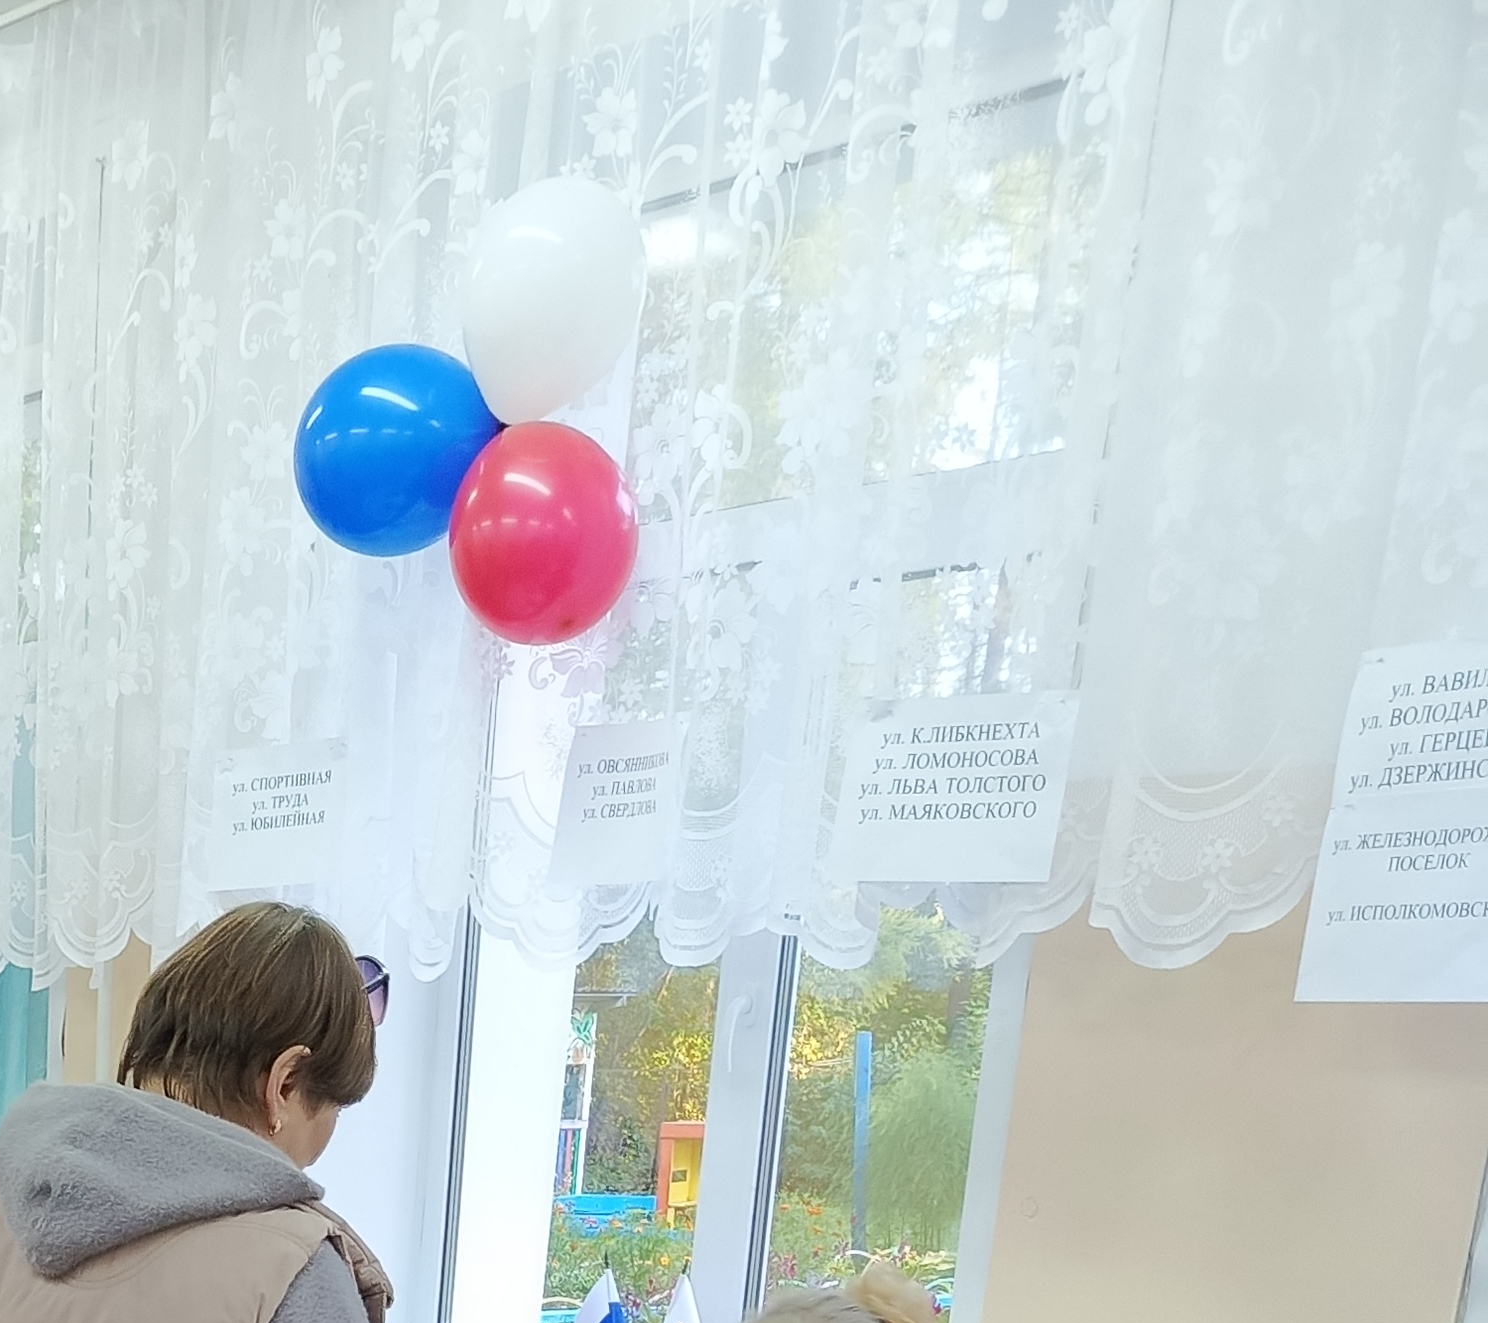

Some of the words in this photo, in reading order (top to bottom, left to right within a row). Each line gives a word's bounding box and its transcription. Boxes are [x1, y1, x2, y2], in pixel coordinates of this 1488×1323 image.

[1388, 683, 1414, 703] ул.
[881, 733, 905, 749] ул.
[910, 722, 1040, 744] К.ЛИБКНЕХТА
[1358, 715, 1383, 736] ул.
[1387, 741, 1413, 761] ул.
[1419, 728, 1488, 753] ГЕРЦЕ
[577, 763, 593, 779] ул.
[872, 758, 897, 774] ул.
[902, 748, 1039, 770] ЛОМОНОСОВА
[232, 783, 248, 796] ул.
[251, 770, 332, 792] СПОРТИВНАЯ
[1348, 774, 1373, 794] ул.
[1377, 758, 1488, 789] ДЗЕРЖИНС
[591, 786, 607, 800] ул.
[858, 783, 882, 800] ул.
[887, 778, 938, 795] ЛЬВА
[946, 774, 1046, 794] ТОЛСТОГО
[252, 800, 267, 814] ул.
[271, 793, 309, 809] ТРУДА
[858, 808, 882, 824] ул.
[888, 800, 1037, 820] МАЯКОВСКОГО
[232, 822, 248, 835] ул.
[251, 810, 325, 831] ЮБИЛЕЙНАЯ
[581, 808, 597, 823] ул.
[1332, 839, 1352, 855] ул.
[1387, 852, 1471, 872] ПОСЕЛОК
[1326, 910, 1346, 926] ул.
